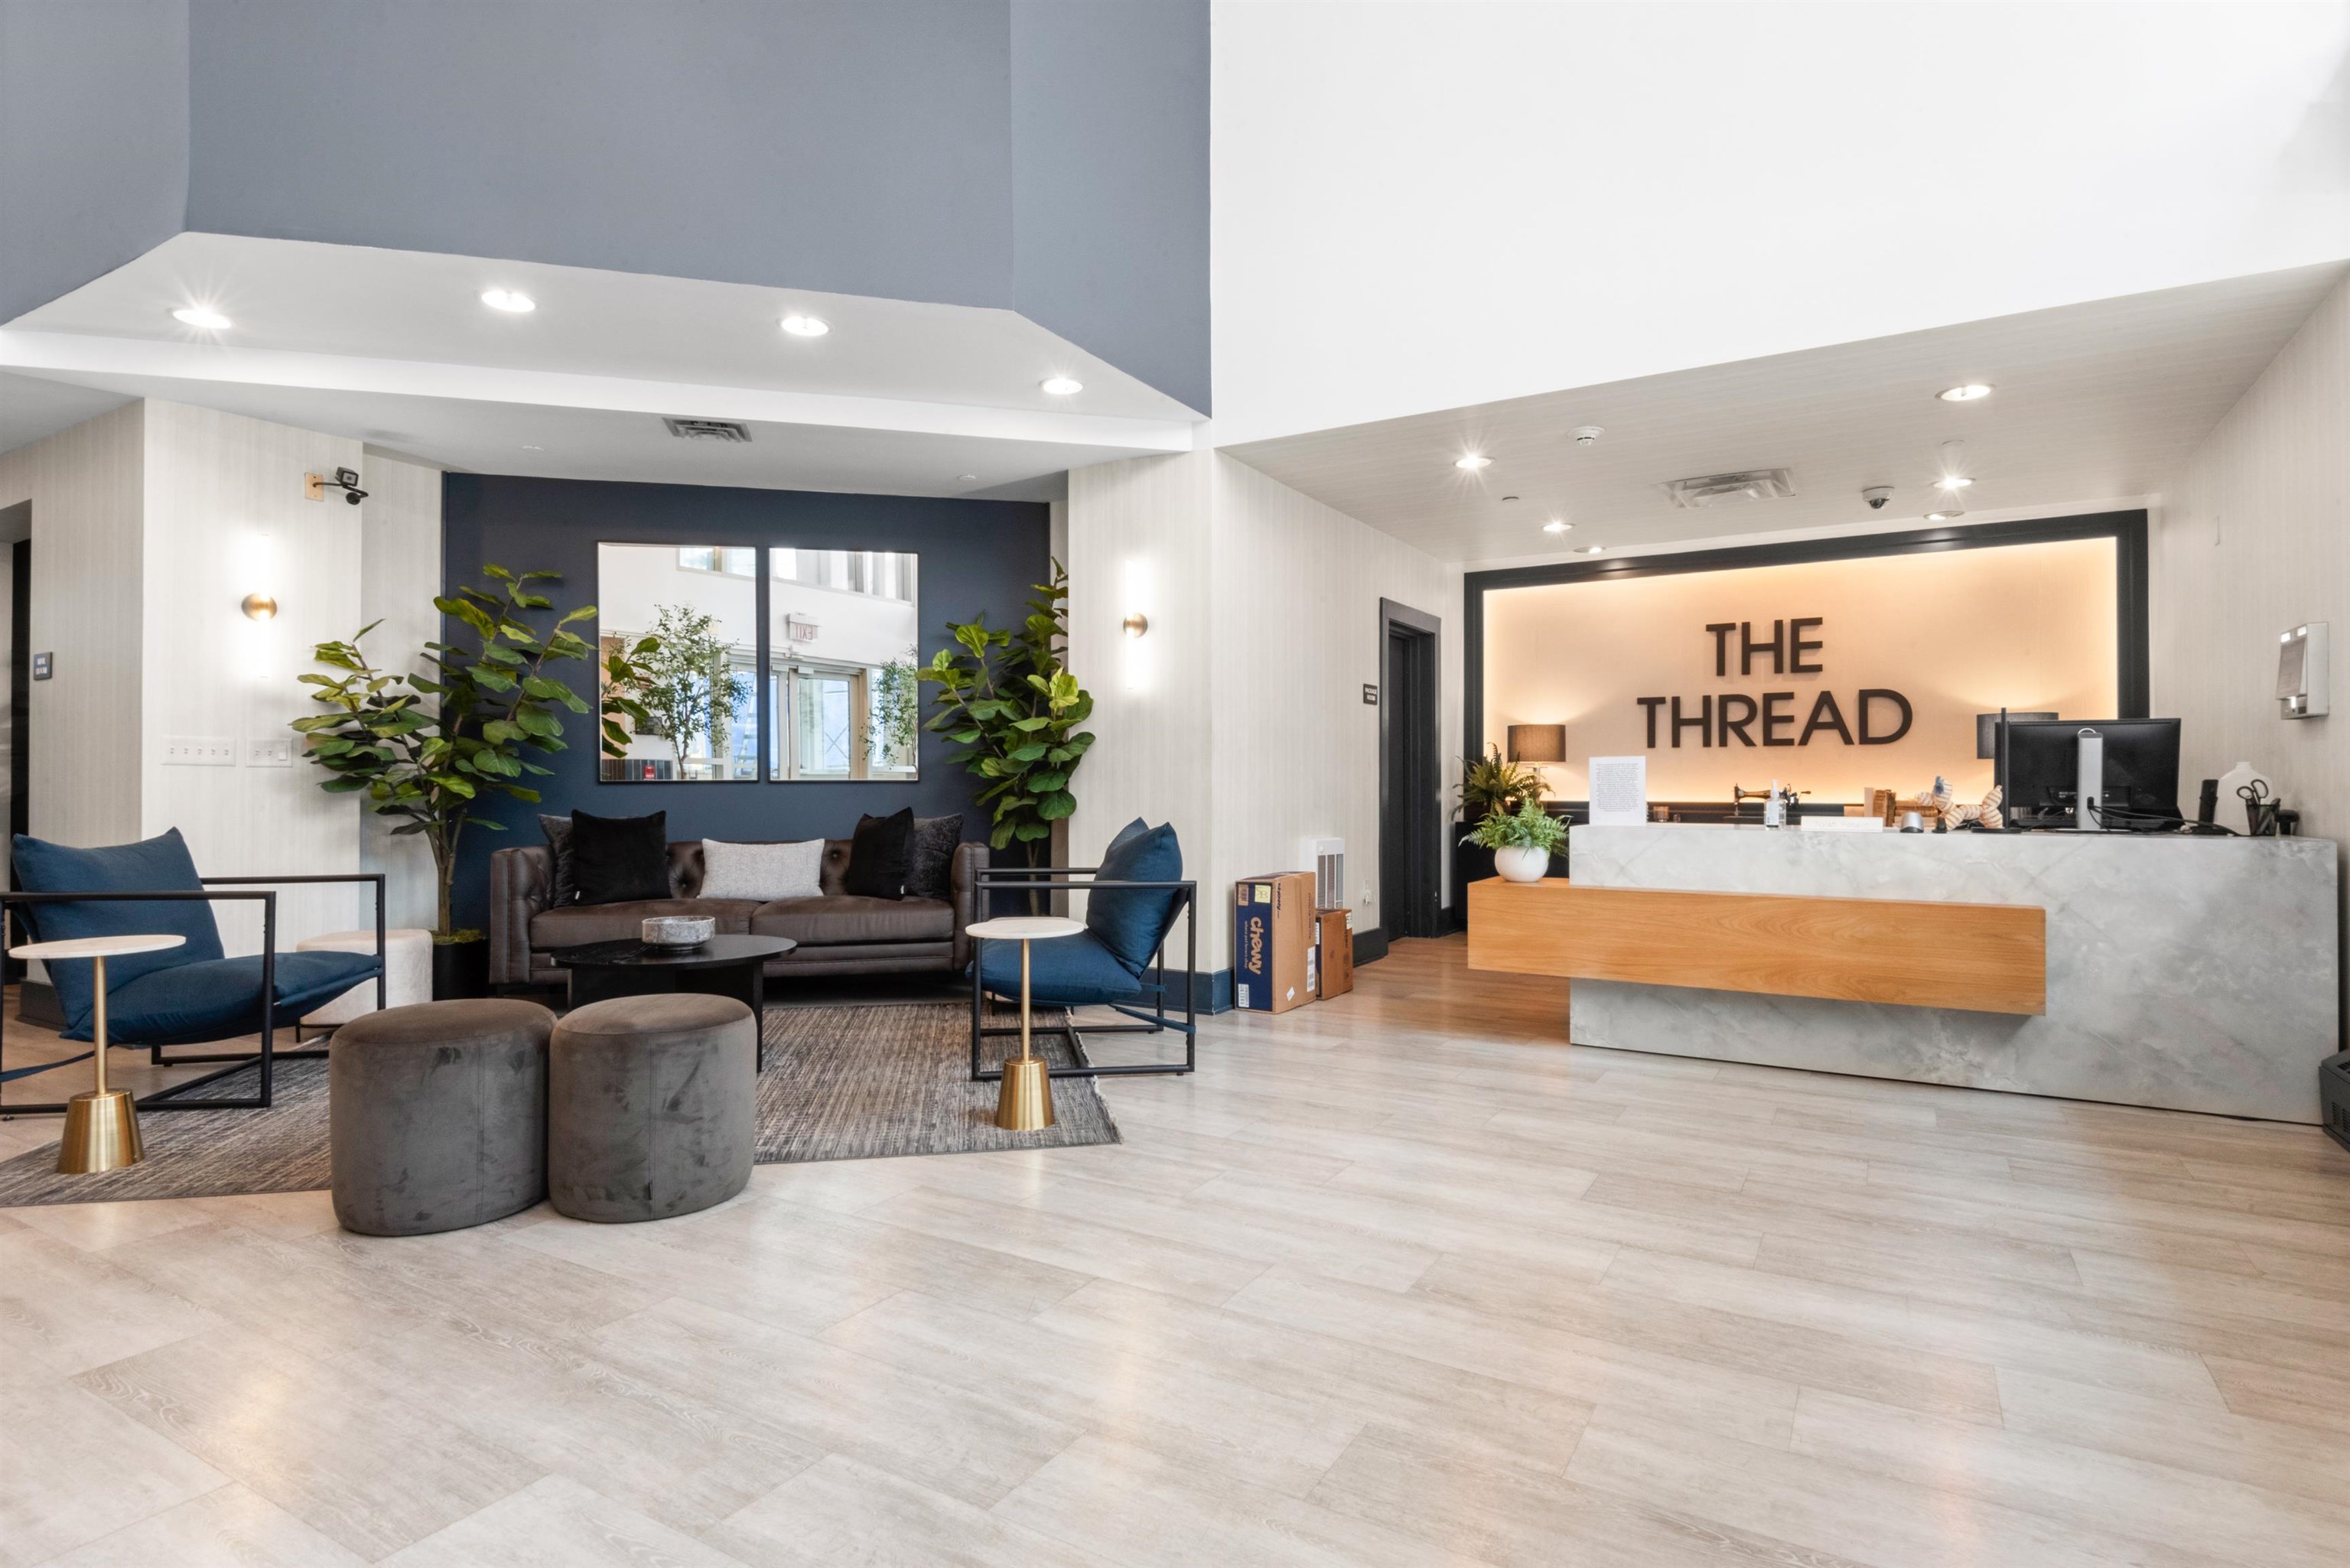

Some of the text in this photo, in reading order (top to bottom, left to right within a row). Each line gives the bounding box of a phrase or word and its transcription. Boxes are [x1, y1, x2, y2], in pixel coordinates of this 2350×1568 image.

[1706, 616, 1823, 677] THE
[1636, 688, 1913, 749] THREAD
[1248, 916, 1264, 975] chewy
